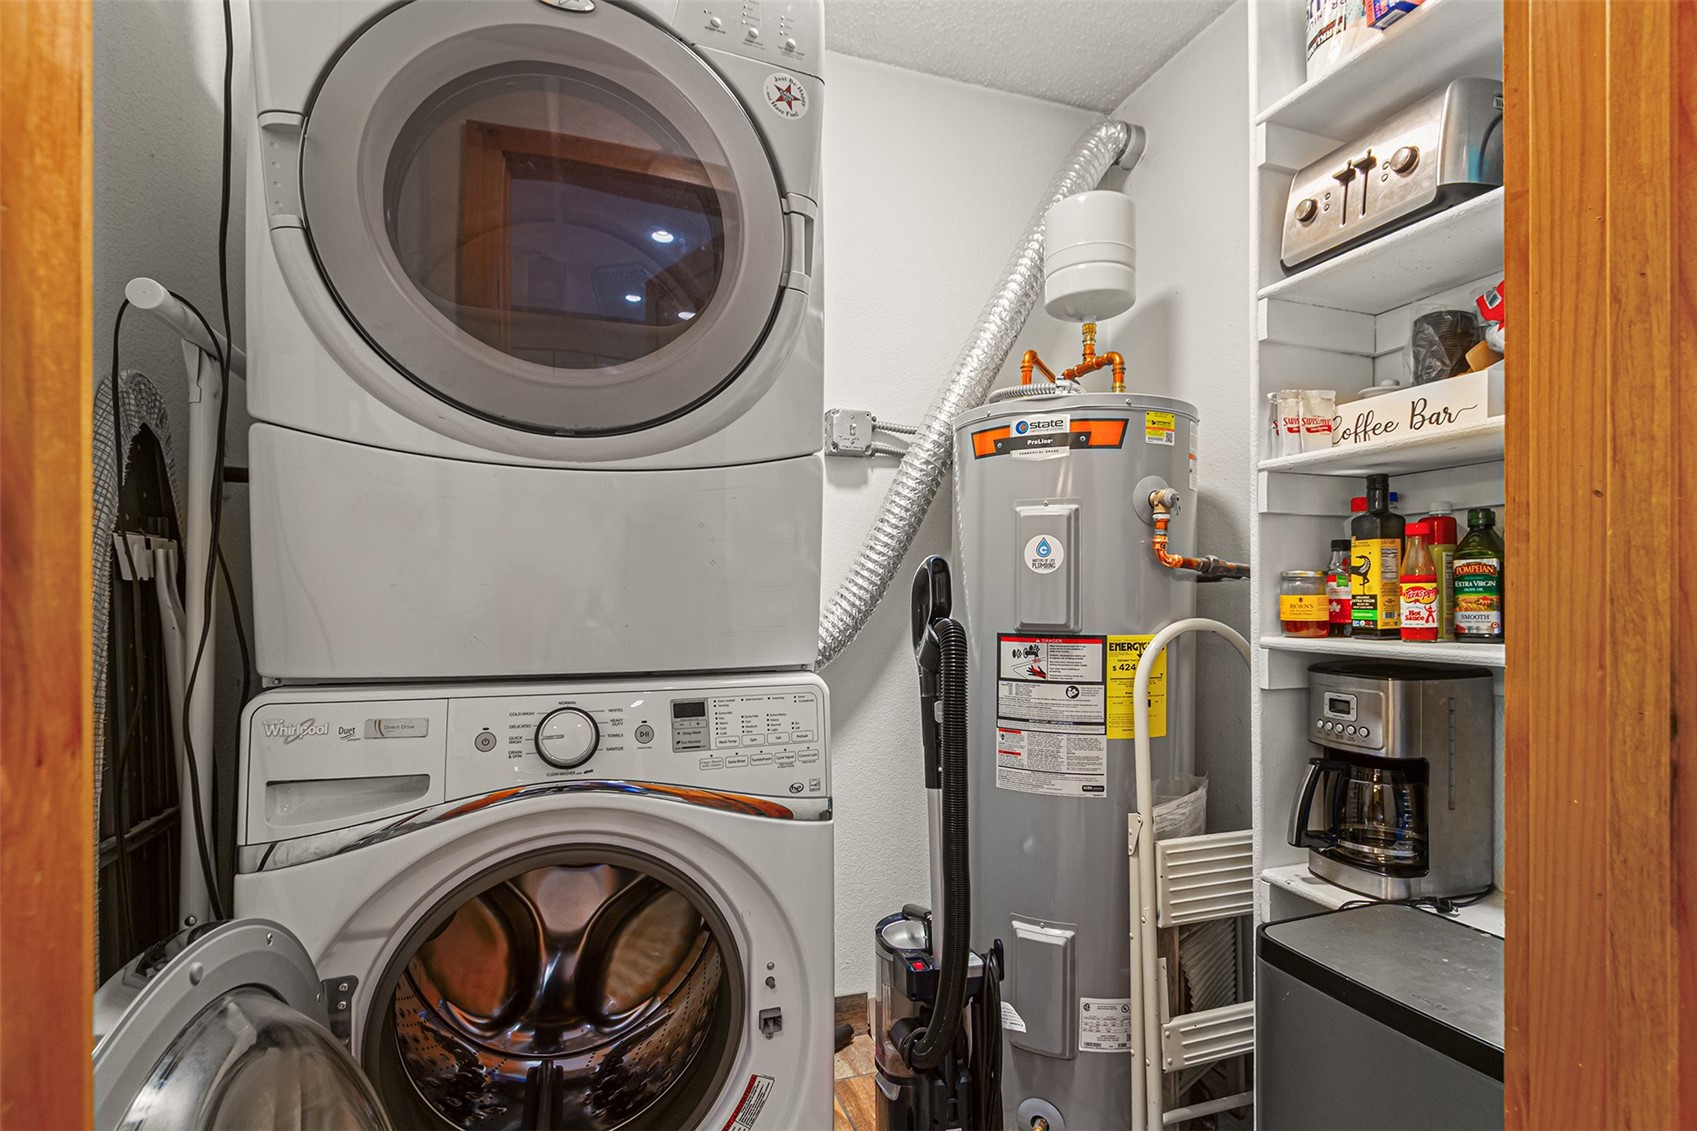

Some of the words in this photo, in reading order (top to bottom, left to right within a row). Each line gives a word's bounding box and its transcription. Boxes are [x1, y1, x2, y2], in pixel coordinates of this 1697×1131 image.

[788, 78, 797, 86] Be
[771, 101, 784, 114] Have
[1030, 419, 1064, 430] state
[1332, 410, 1402, 445] Coffee
[1410, 397, 1478, 430] Bar
[1456, 564, 1494, 574] POMPEIAN
[263, 719, 329, 740] Whirlpool
[338, 726, 356, 735] Duet
